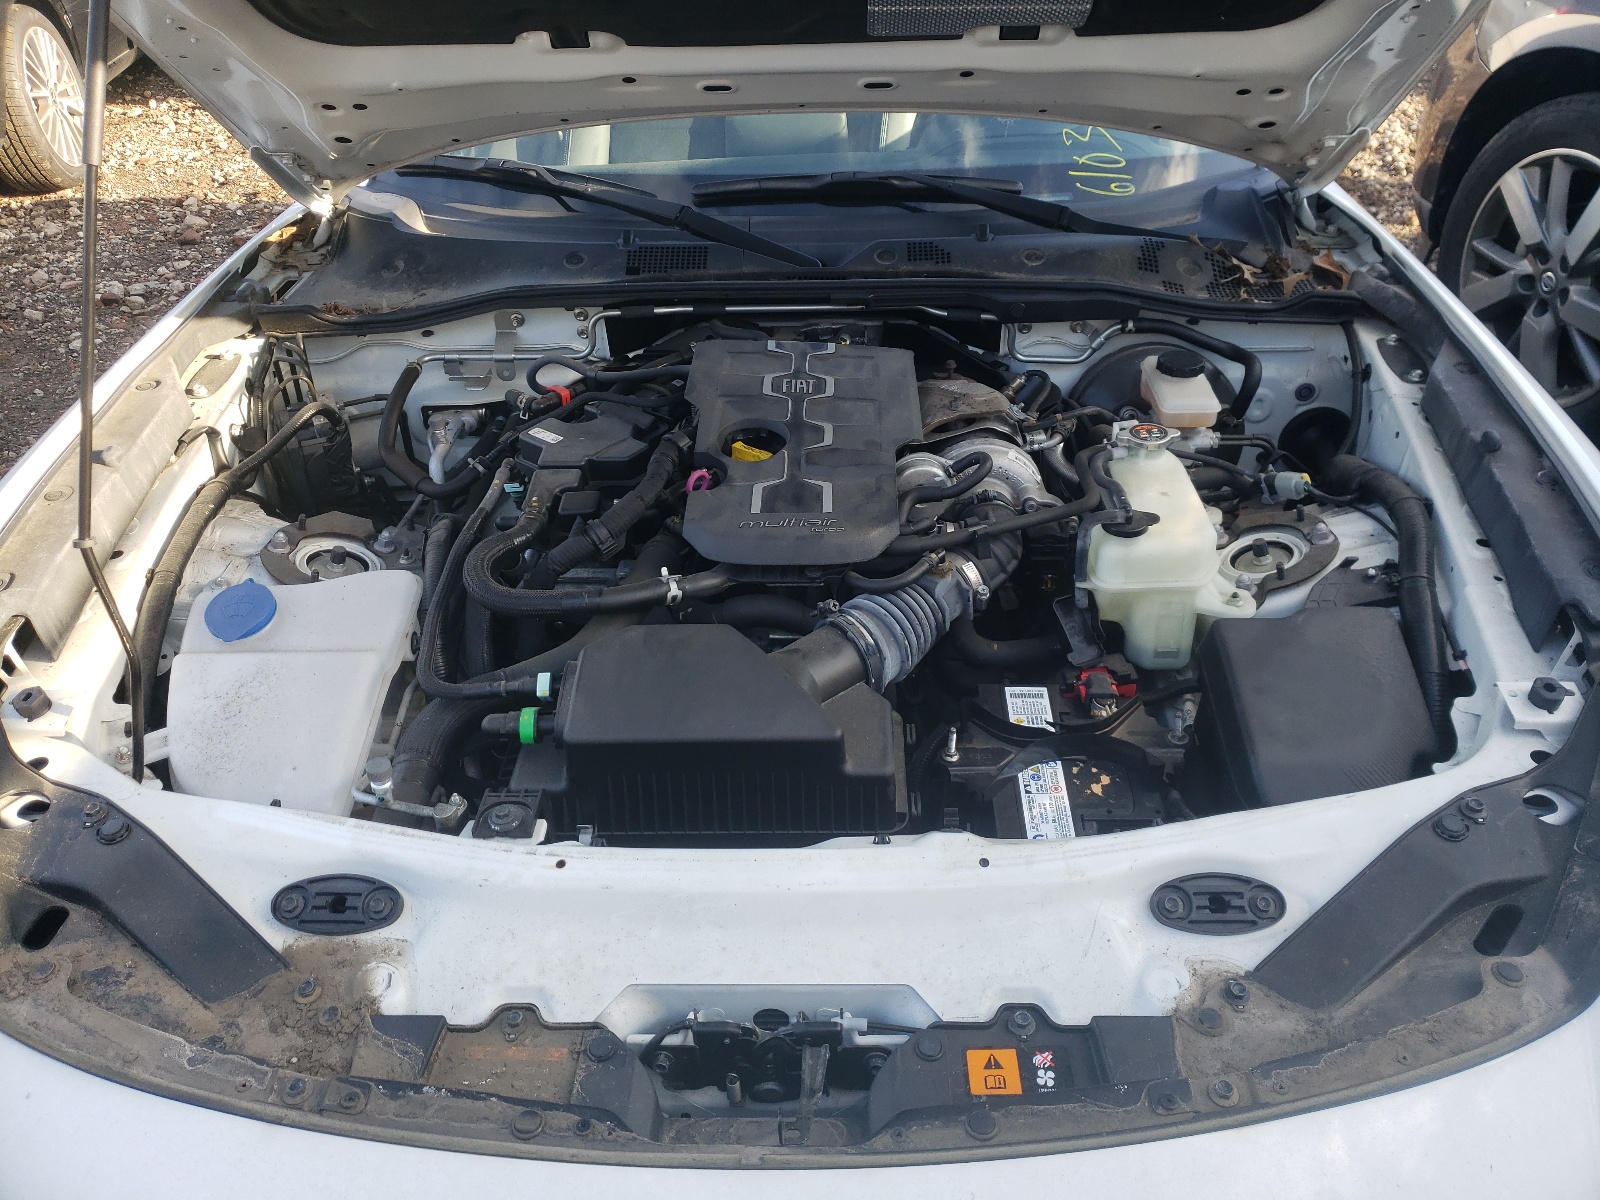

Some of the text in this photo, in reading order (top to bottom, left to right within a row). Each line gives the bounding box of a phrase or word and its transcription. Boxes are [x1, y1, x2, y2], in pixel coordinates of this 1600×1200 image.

[1063, 126, 1135, 196] 6103
[783, 379, 815, 393] FIAT
[740, 517, 837, 527] multiair
